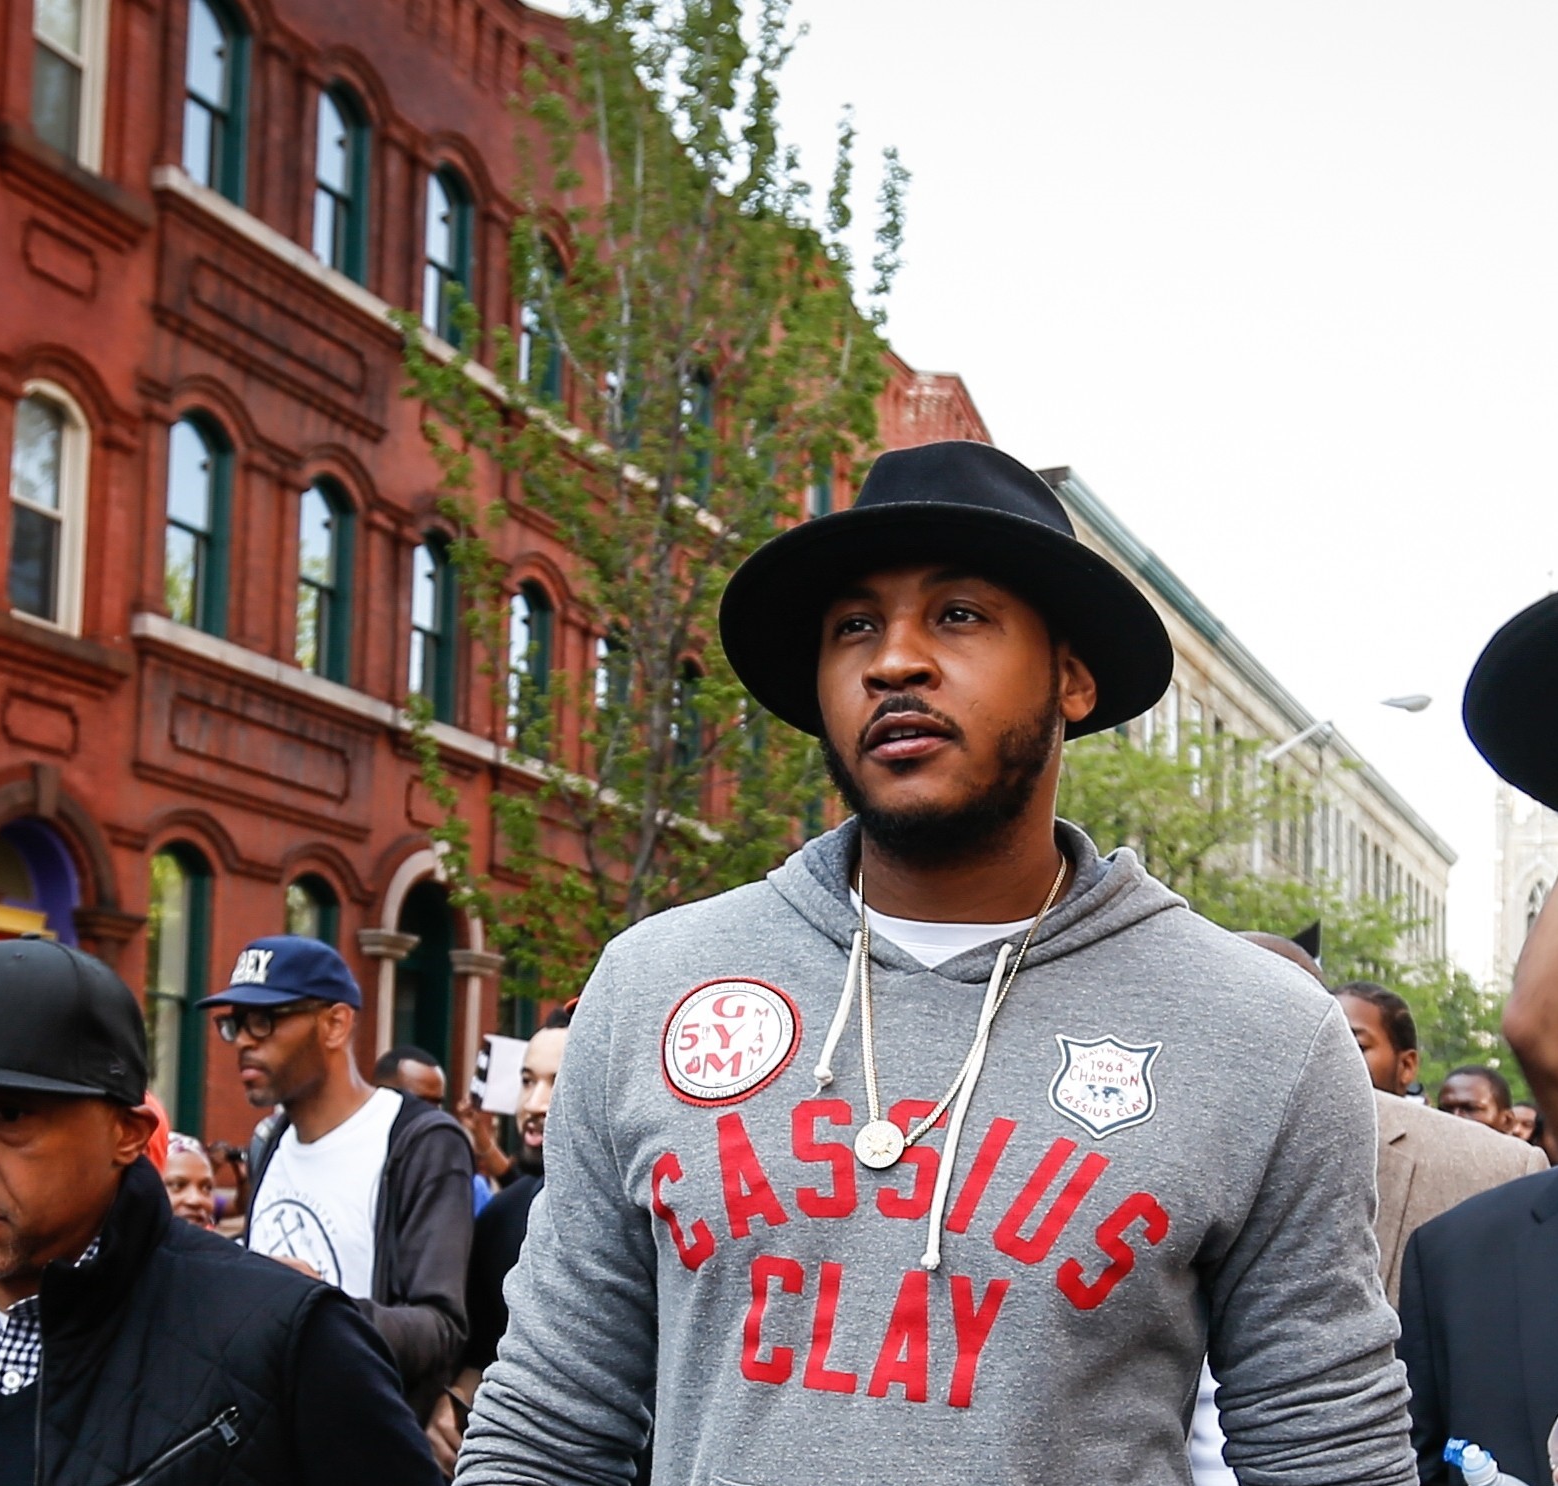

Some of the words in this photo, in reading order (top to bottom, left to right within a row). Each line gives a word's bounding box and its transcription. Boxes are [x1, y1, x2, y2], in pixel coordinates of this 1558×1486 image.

[1076, 1047, 1139, 1068] HEAVYWEIGHT
[1091, 1060, 1124, 1073] 1964
[1060, 1088, 1111, 1118] CASSIUS
[1116, 1097, 1147, 1117] CLAY
[651, 1099, 1169, 1310] CASSIUS
[740, 1255, 1010, 1408] CLAY
